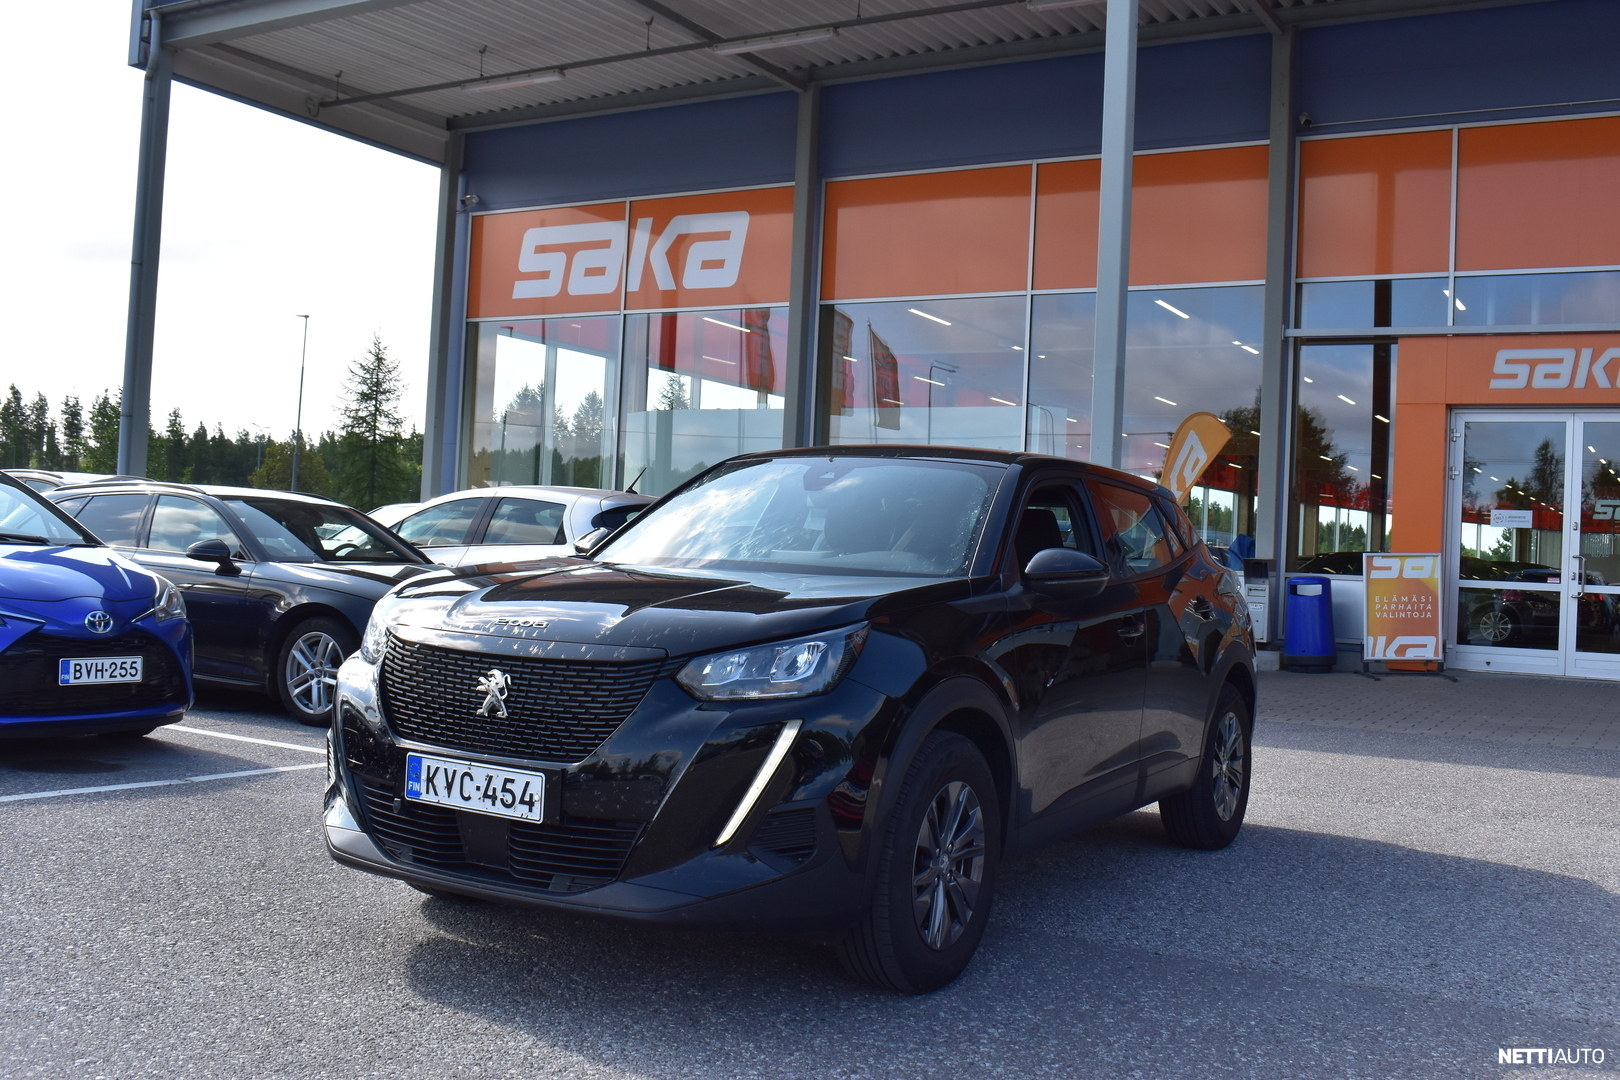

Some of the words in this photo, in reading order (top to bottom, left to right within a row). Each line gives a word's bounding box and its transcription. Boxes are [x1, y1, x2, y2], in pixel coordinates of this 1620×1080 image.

[1375, 594, 1432, 602] ELÄMÄSI
[494, 618, 549, 628] 2008
[408, 781, 420, 792] FIN
